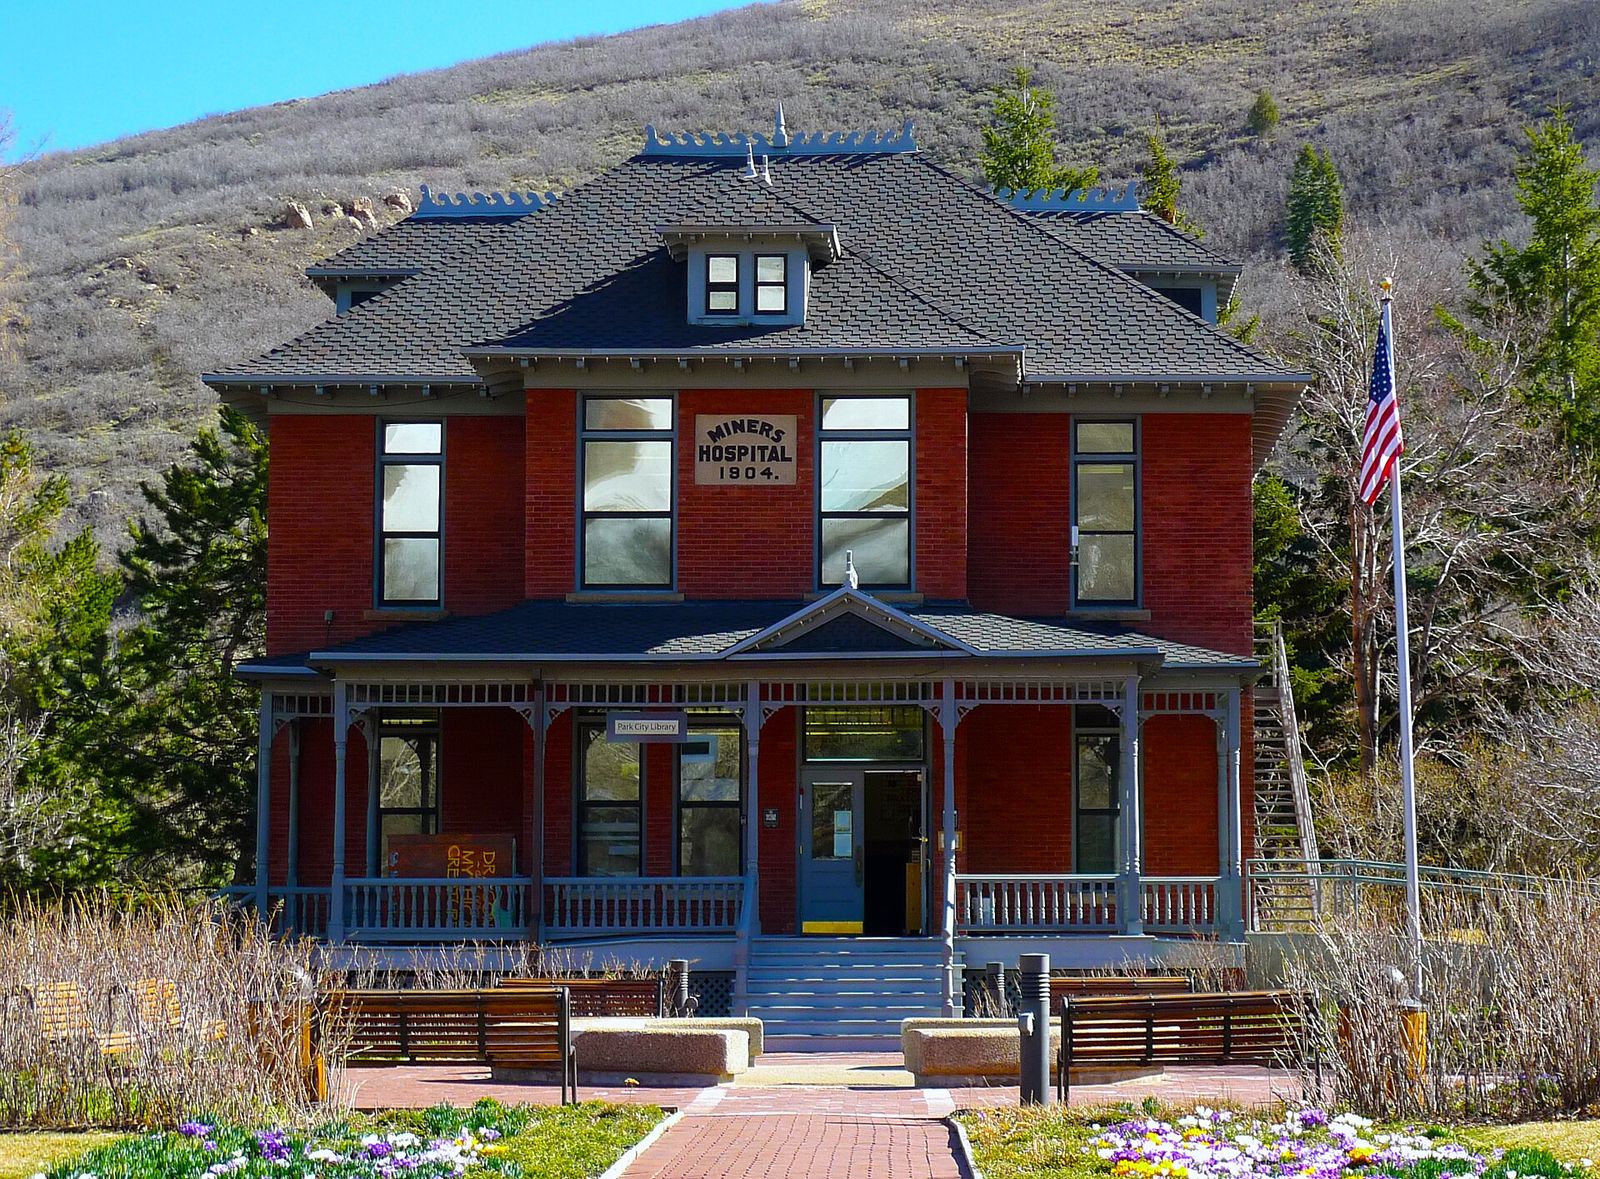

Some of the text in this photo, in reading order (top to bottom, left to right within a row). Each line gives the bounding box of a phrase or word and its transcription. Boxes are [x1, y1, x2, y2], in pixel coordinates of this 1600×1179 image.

[706, 419, 786, 443] MINERS
[698, 445, 793, 462] HOSPITAL
[719, 466, 779, 479] 1904.
[617, 722, 677, 733] Park City Library
